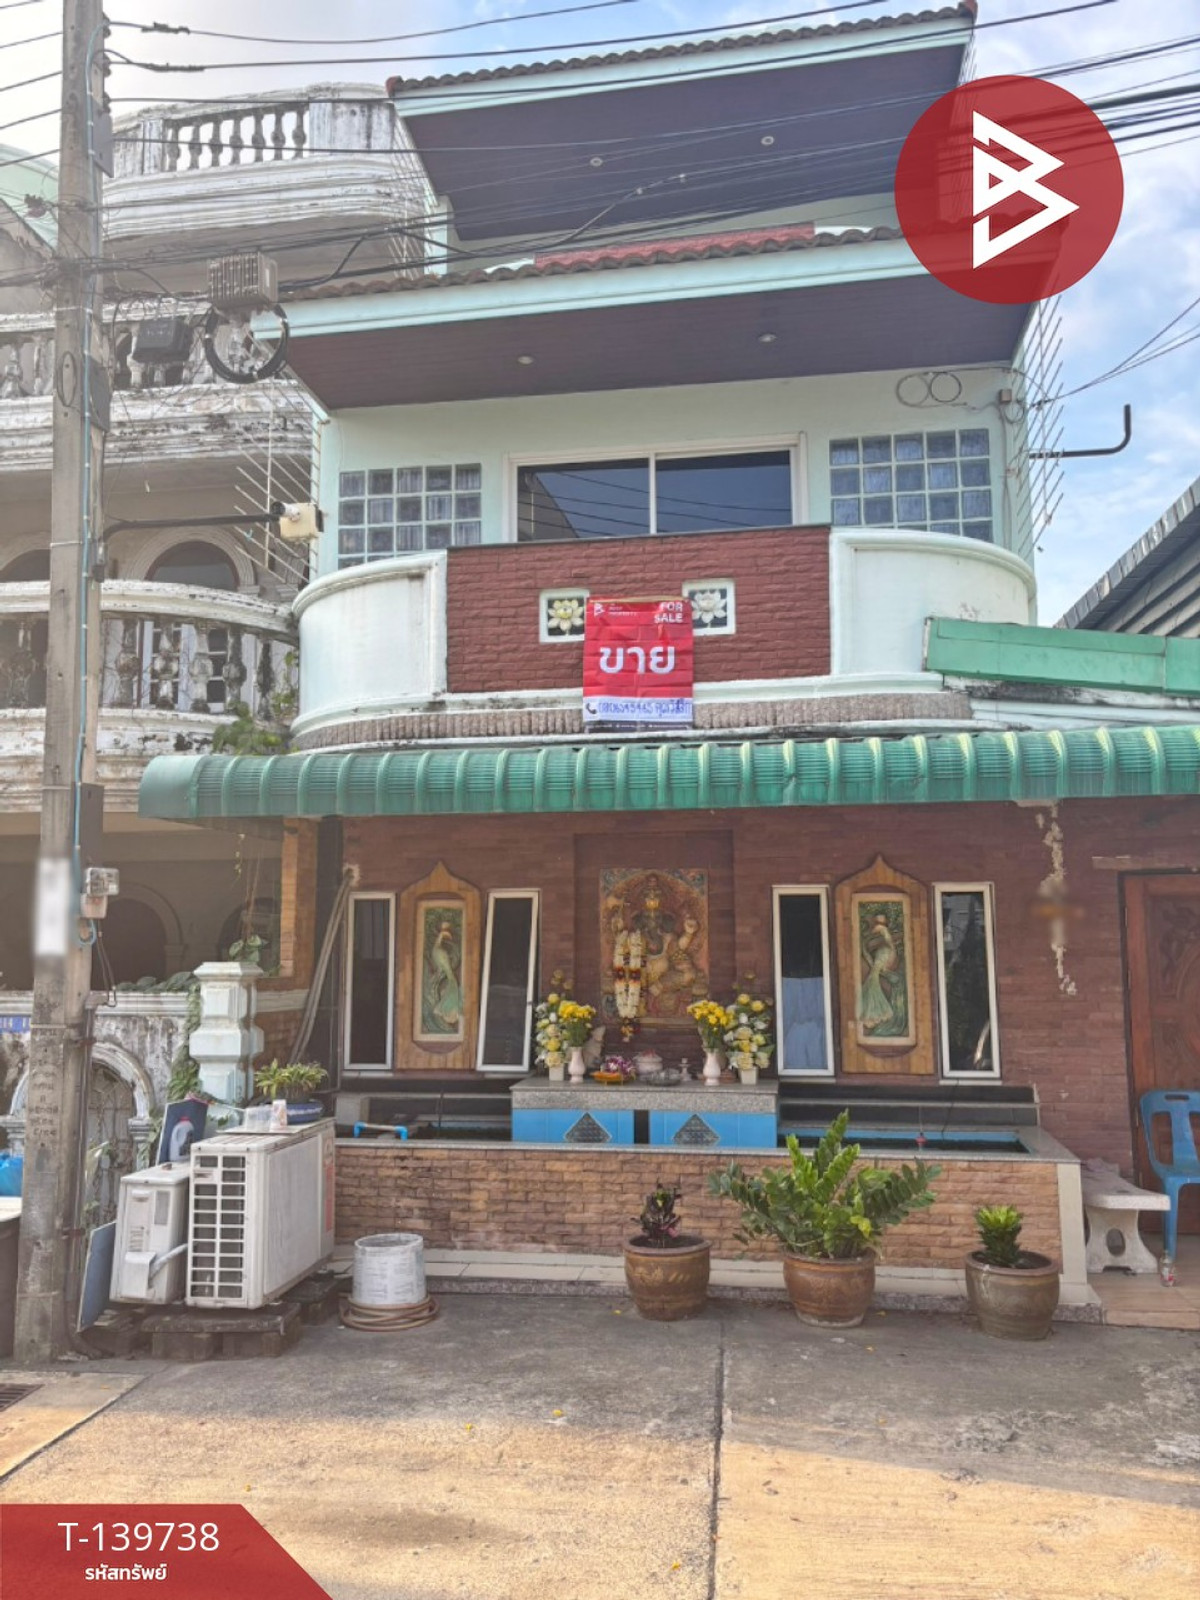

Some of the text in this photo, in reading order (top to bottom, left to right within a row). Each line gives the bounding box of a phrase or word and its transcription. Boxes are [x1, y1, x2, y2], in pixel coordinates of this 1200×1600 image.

[659, 601, 683, 612] FOR
[654, 612, 683, 624] SALE
[599, 645, 675, 675] ขาย
